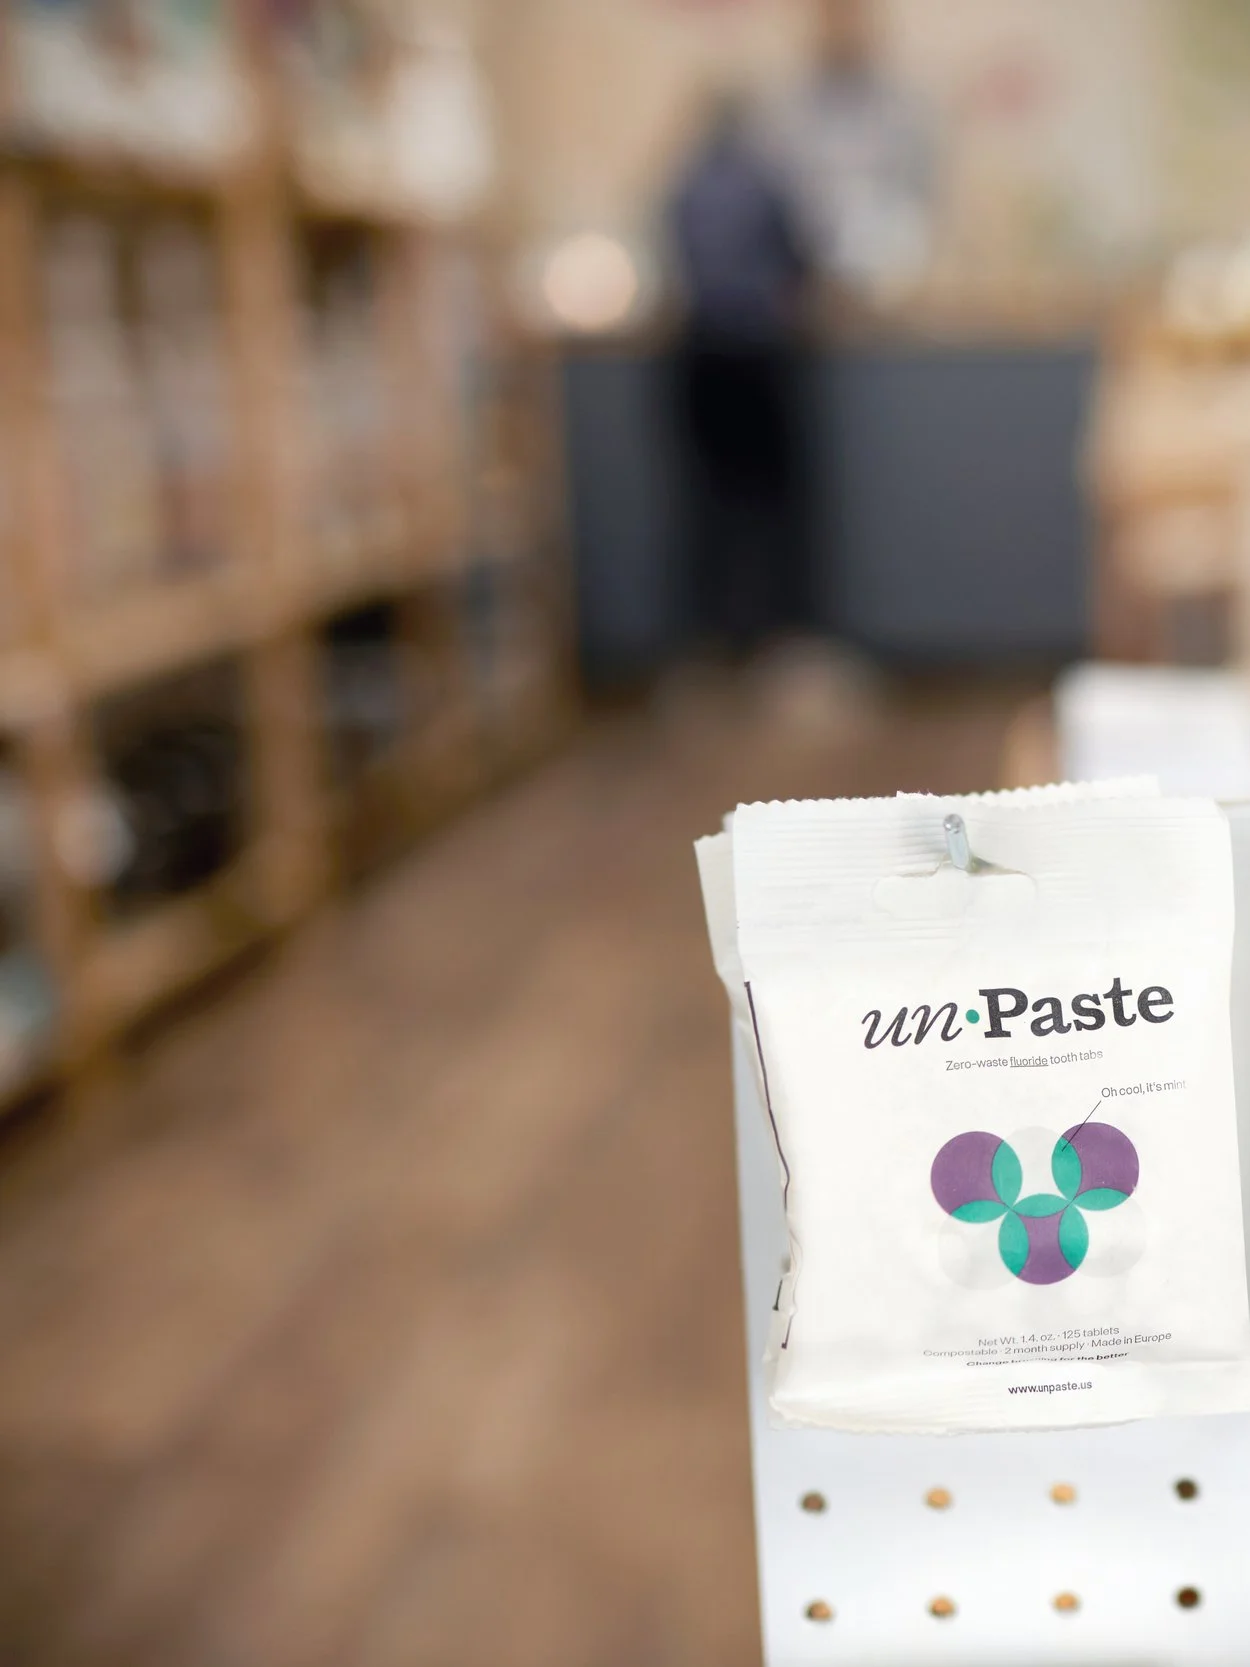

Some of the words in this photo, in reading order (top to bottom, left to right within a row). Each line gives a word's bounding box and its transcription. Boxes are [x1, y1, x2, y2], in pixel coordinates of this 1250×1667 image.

[946, 1055, 1008, 1072] Zero-waste
[1010, 1054, 1049, 1069] fluoride
[1050, 1052, 1078, 1065] tooth
[1079, 1050, 1104, 1063] tabs
[1101, 1087, 1118, 1098] Oh
[1119, 1083, 1146, 1096] cool,
[1163, 1080, 1187, 1091] mint
[922, 1348, 998, 1359] Compostable
[1004, 1346, 1012, 1355] 2
[1013, 1344, 1048, 1355] month
[1049, 1340, 1086, 1354] supply
[1091, 1336, 1123, 1348] Made
[1123, 1335, 1133, 1346] in
[1134, 1331, 1173, 1345] Europe
[978, 1337, 998, 1348] Net
[1062, 1329, 1081, 1340] 125
[1082, 1326, 1120, 1338] tablets
[1007, 1379, 1093, 1395] www.unpaste.us
